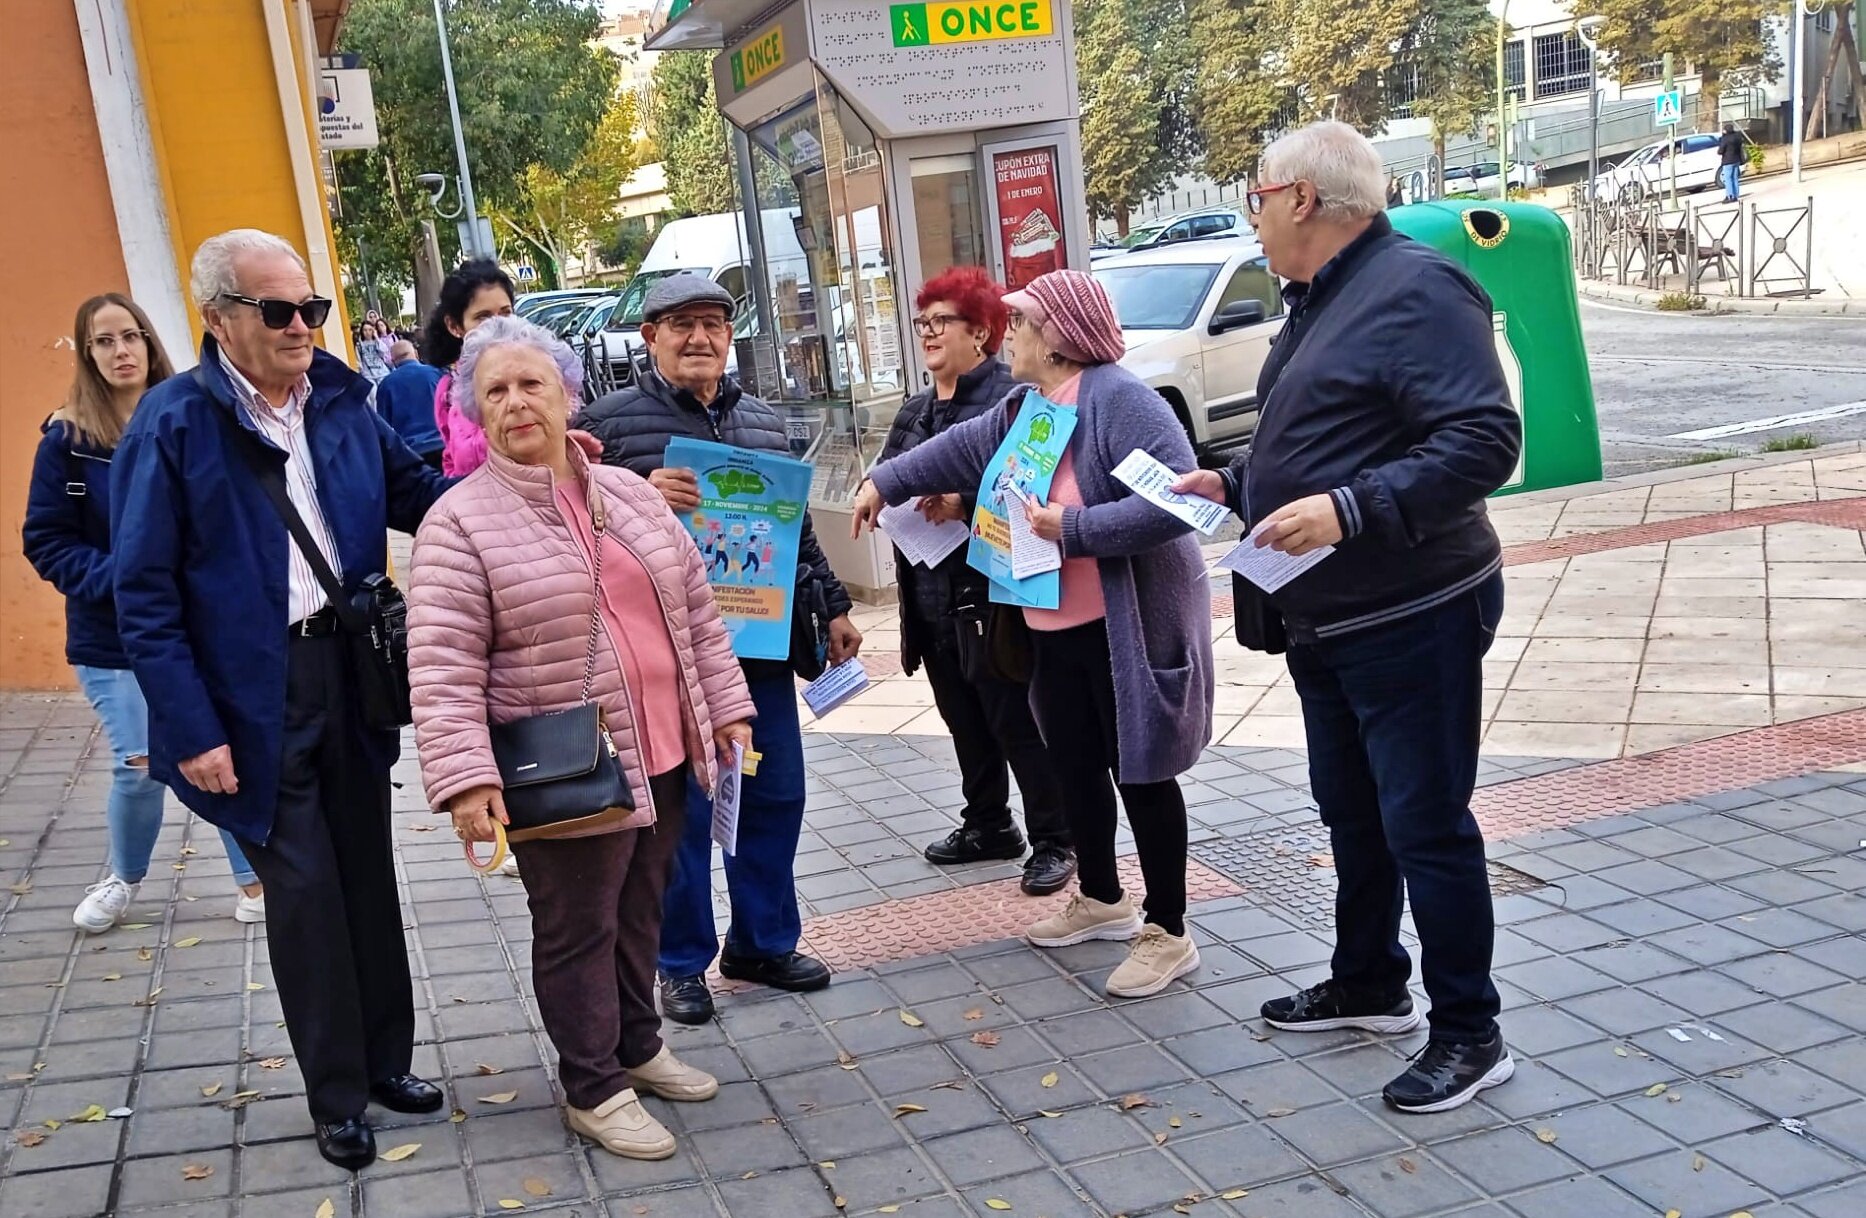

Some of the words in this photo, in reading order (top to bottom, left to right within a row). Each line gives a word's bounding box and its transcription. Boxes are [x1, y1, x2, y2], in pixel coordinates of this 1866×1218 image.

[941, 2, 1040, 37] ONCE
[747, 31, 780, 77] ONCE
[320, 124, 350, 132] puestas
[321, 132, 342, 140] stado
[1023, 153, 1050, 167] EXTRA
[998, 171, 1010, 183] DE
[1011, 165, 1048, 181] NAVIDAD
[1007, 191, 1011, 199] 1
[1011, 190, 1020, 198] DE
[1021, 186, 1043, 198] ENERO
[703, 499, 711, 507] 17
[721, 605, 735, 613] POR
[736, 605, 745, 613] TU
